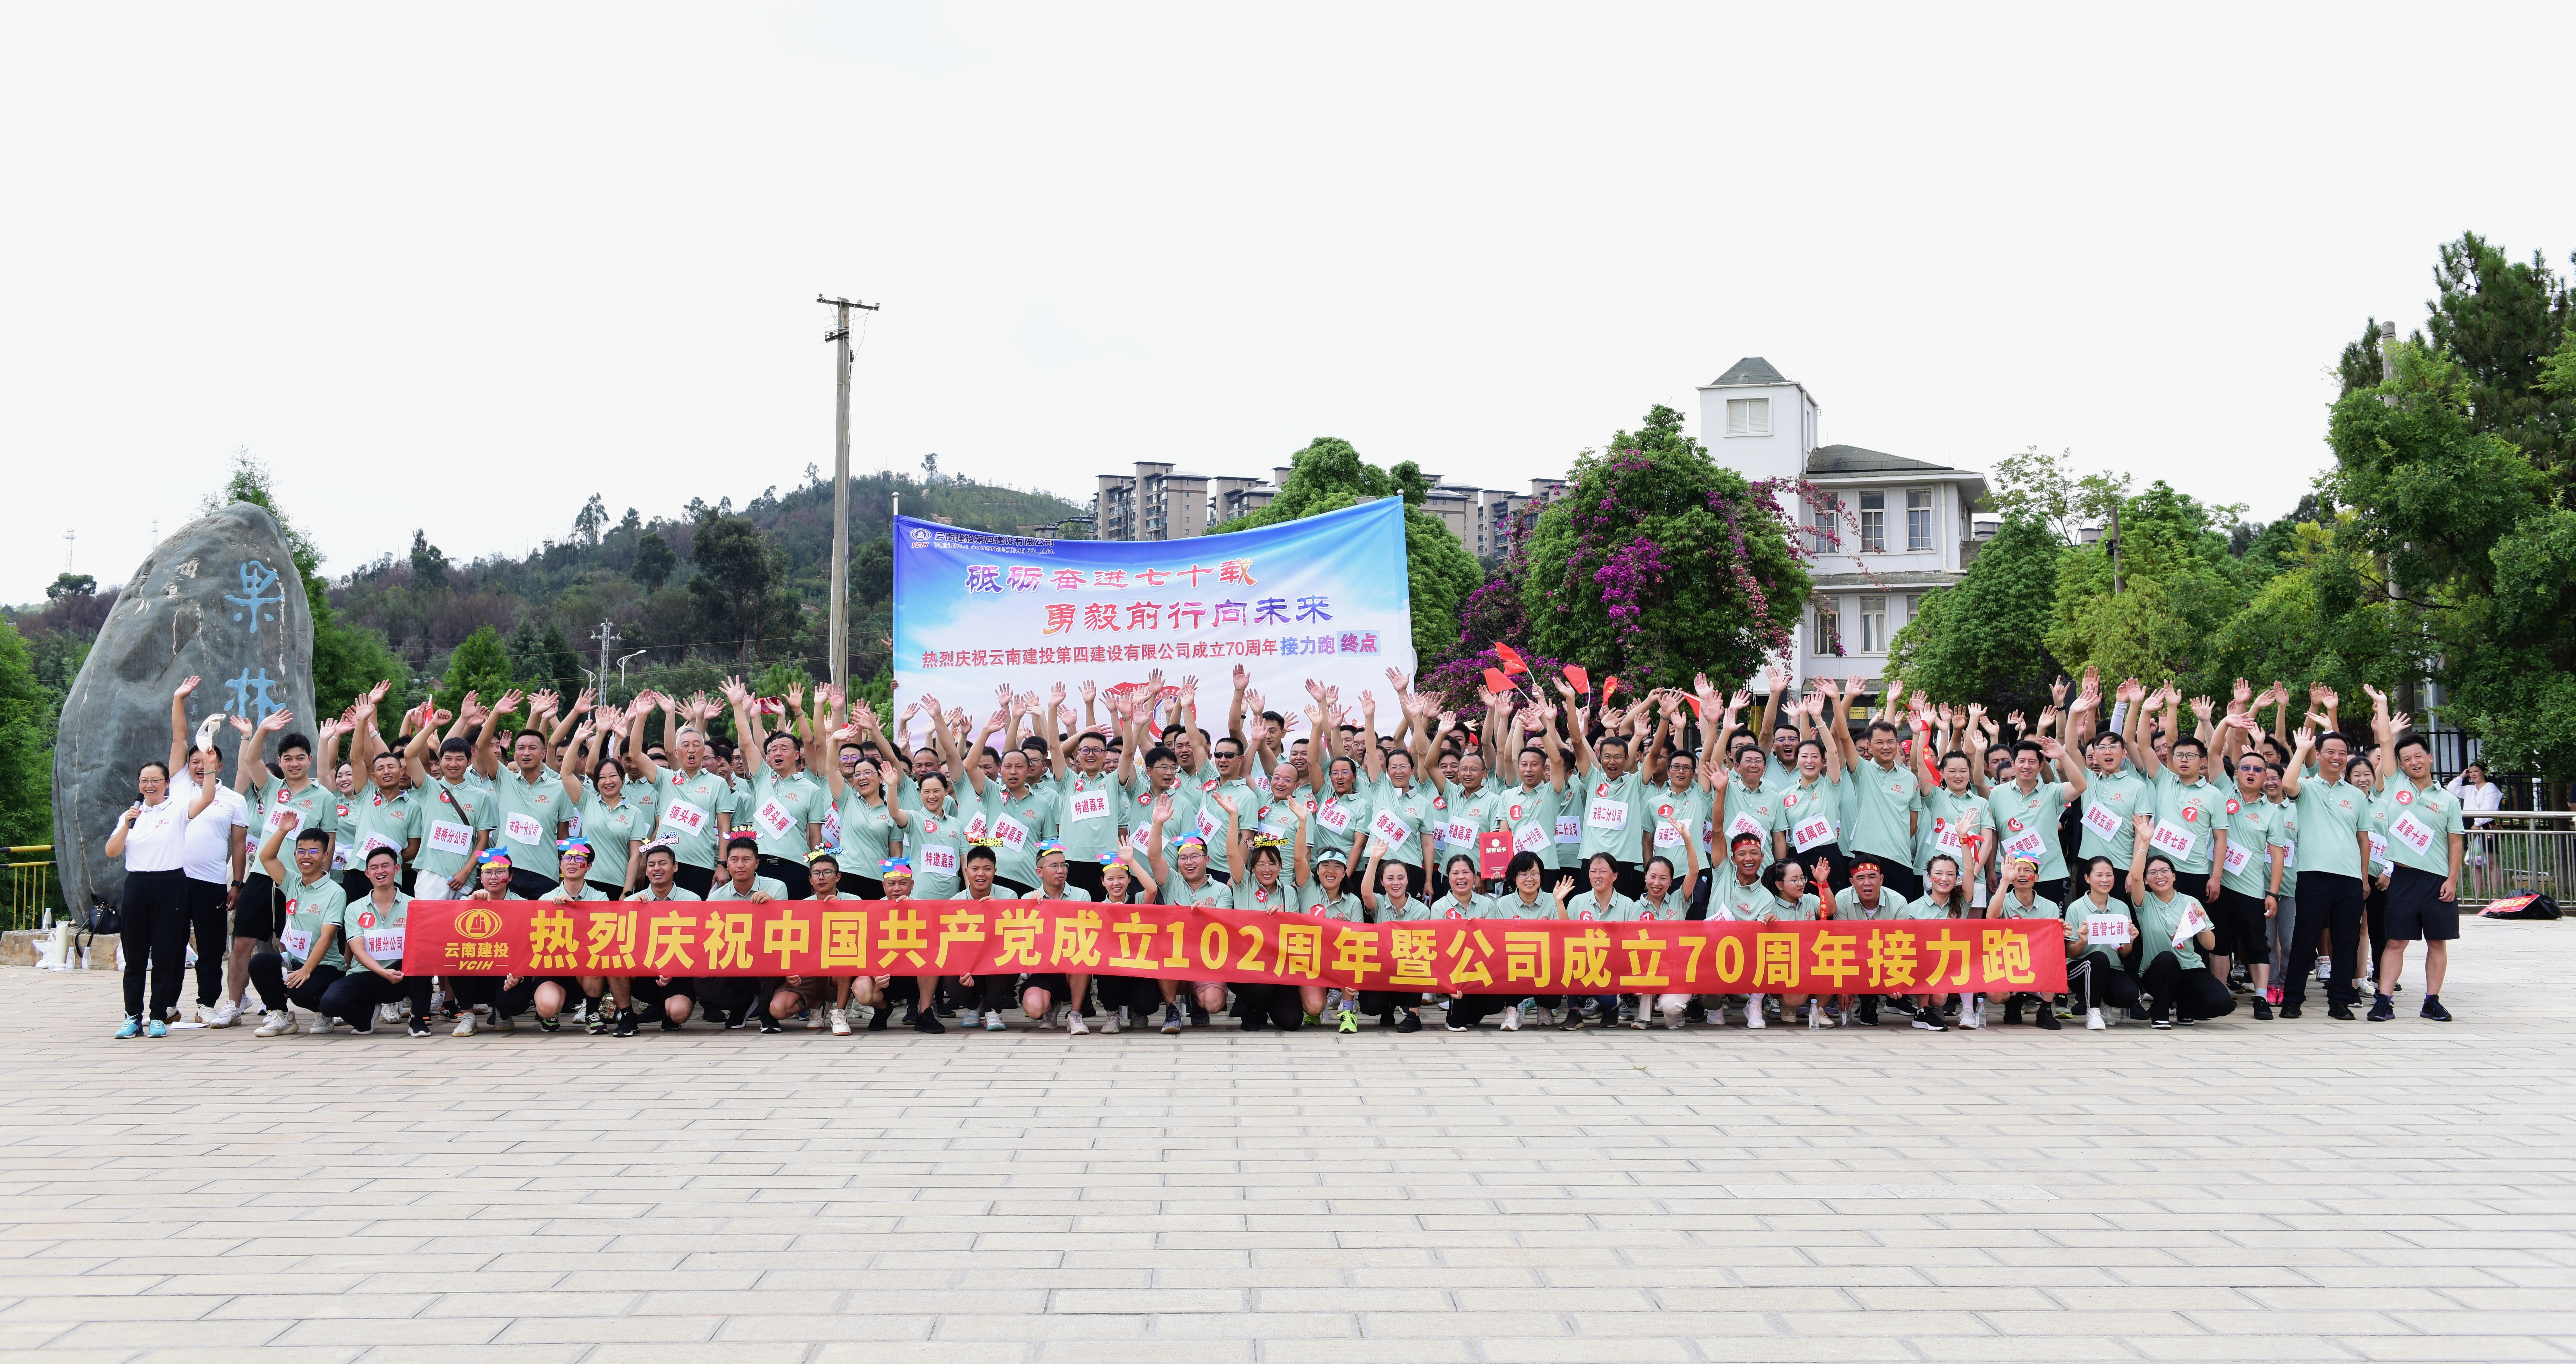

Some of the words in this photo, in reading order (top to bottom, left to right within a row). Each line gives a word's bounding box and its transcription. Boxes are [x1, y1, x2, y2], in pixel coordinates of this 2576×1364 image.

[935, 532, 1054, 547] 云南建投第四建设有限公司
[971, 545, 1026, 554] CONSTRUCTION
[966, 558, 1258, 594] 砥砺奋进七十载
[1042, 594, 1334, 636] 勇毅前行向未来
[223, 560, 286, 727] 果林
[922, 635, 1336, 669] 热烈庆祝云南建投第四建设有限公司成立70周年接力跑
[1340, 633, 1378, 654] 终点
[1077, 781, 1083, 790] 7
[1206, 782, 1213, 791] 3
[1599, 786, 1607, 795] 1
[280, 791, 287, 801] 5
[1141, 794, 1149, 803] 6
[2399, 793, 2410, 802] 3
[1075, 798, 1105, 815] 特邀嘉宾
[1308, 803, 1315, 811] 3
[1513, 807, 1520, 818] 1
[1663, 807, 1668, 816] 1
[2227, 802, 2236, 811] 4
[669, 805, 701, 827] 领头雁
[763, 803, 790, 831] 领头雁
[1320, 807, 1347, 827] 特邀嘉宾
[1592, 806, 1622, 823] 安装二分公司
[2087, 807, 2115, 832] 直管五部
[2187, 809, 2195, 820] 7
[510, 820, 539, 836] 市政一分公司
[926, 822, 932, 831] 3
[996, 821, 1023, 844] 特邀嘉宾
[1377, 815, 1405, 842] 领头雁
[1448, 823, 1472, 841] 特邀嘉宾
[1554, 823, 1578, 836] 装二分公司
[1796, 822, 1827, 845] 直属四
[2396, 819, 2428, 847] 直管十部
[433, 827, 469, 846] 路桥分公司
[969, 837, 1003, 847] 一马当先
[2155, 827, 2188, 852] 直管七部
[824, 847, 842, 855] Keep
[925, 851, 954, 870] 特邀嘉宾
[1257, 890, 1265, 900] 3
[288, 902, 295, 912] 4
[1314, 906, 1322, 916] 7
[363, 915, 371, 926] 7
[2092, 921, 2124, 937] 直管七部
[369, 937, 402, 953] 滑模分公司
[444, 943, 509, 958] 云南建投
[529, 908, 2035, 988] 热烈庆祝中国共产党成立102周年暨公司成立70周年接力跑
[457, 961, 493, 970] YCIH
